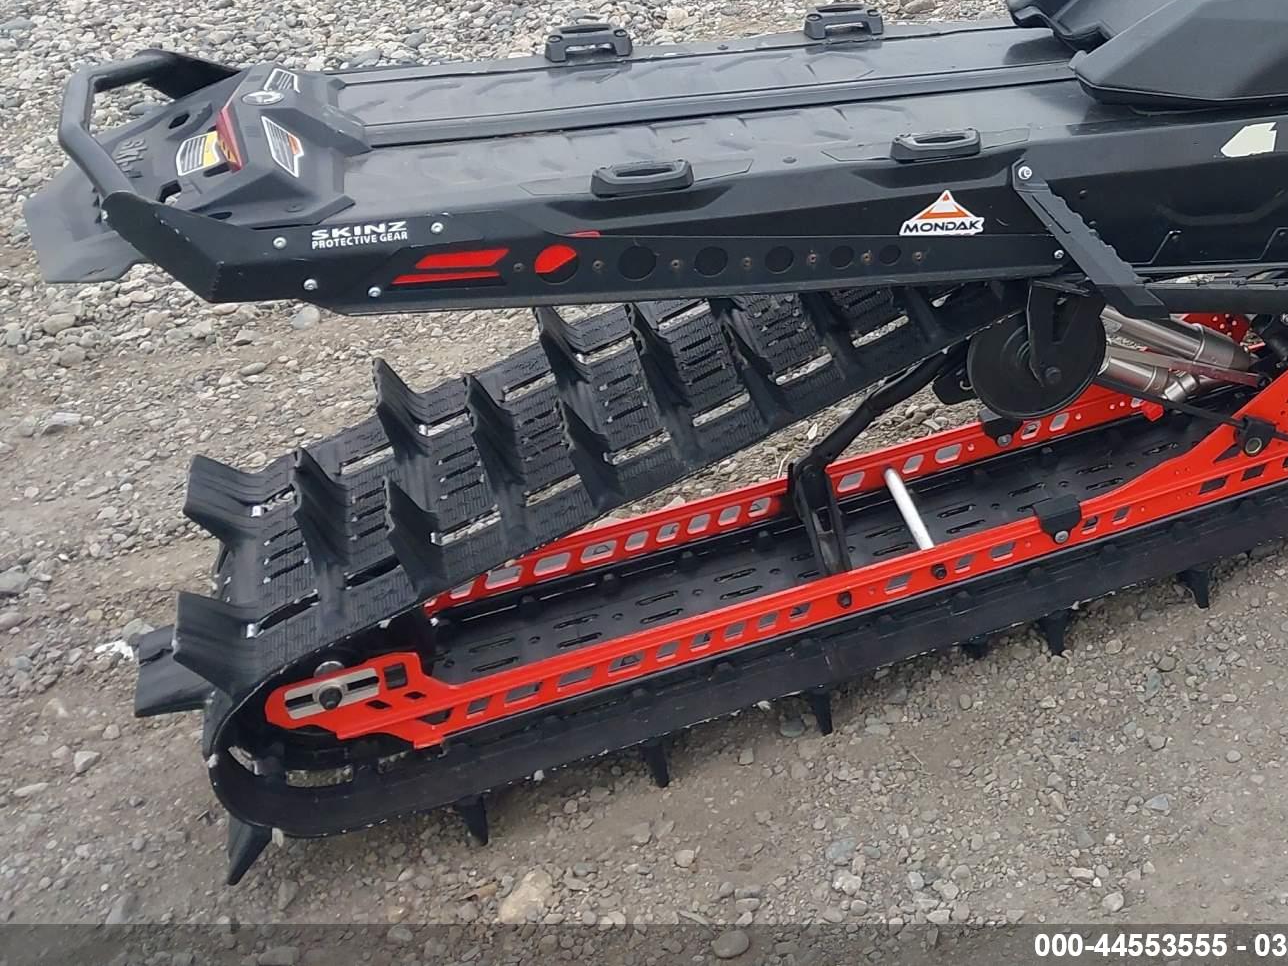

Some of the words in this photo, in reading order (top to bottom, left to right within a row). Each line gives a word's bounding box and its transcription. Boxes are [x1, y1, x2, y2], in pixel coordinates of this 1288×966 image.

[311, 220, 408, 241] SKINZ
[903, 219, 981, 234] MONDAK
[311, 233, 378, 250] PROTECTIVE
[379, 231, 408, 242] GEAR
